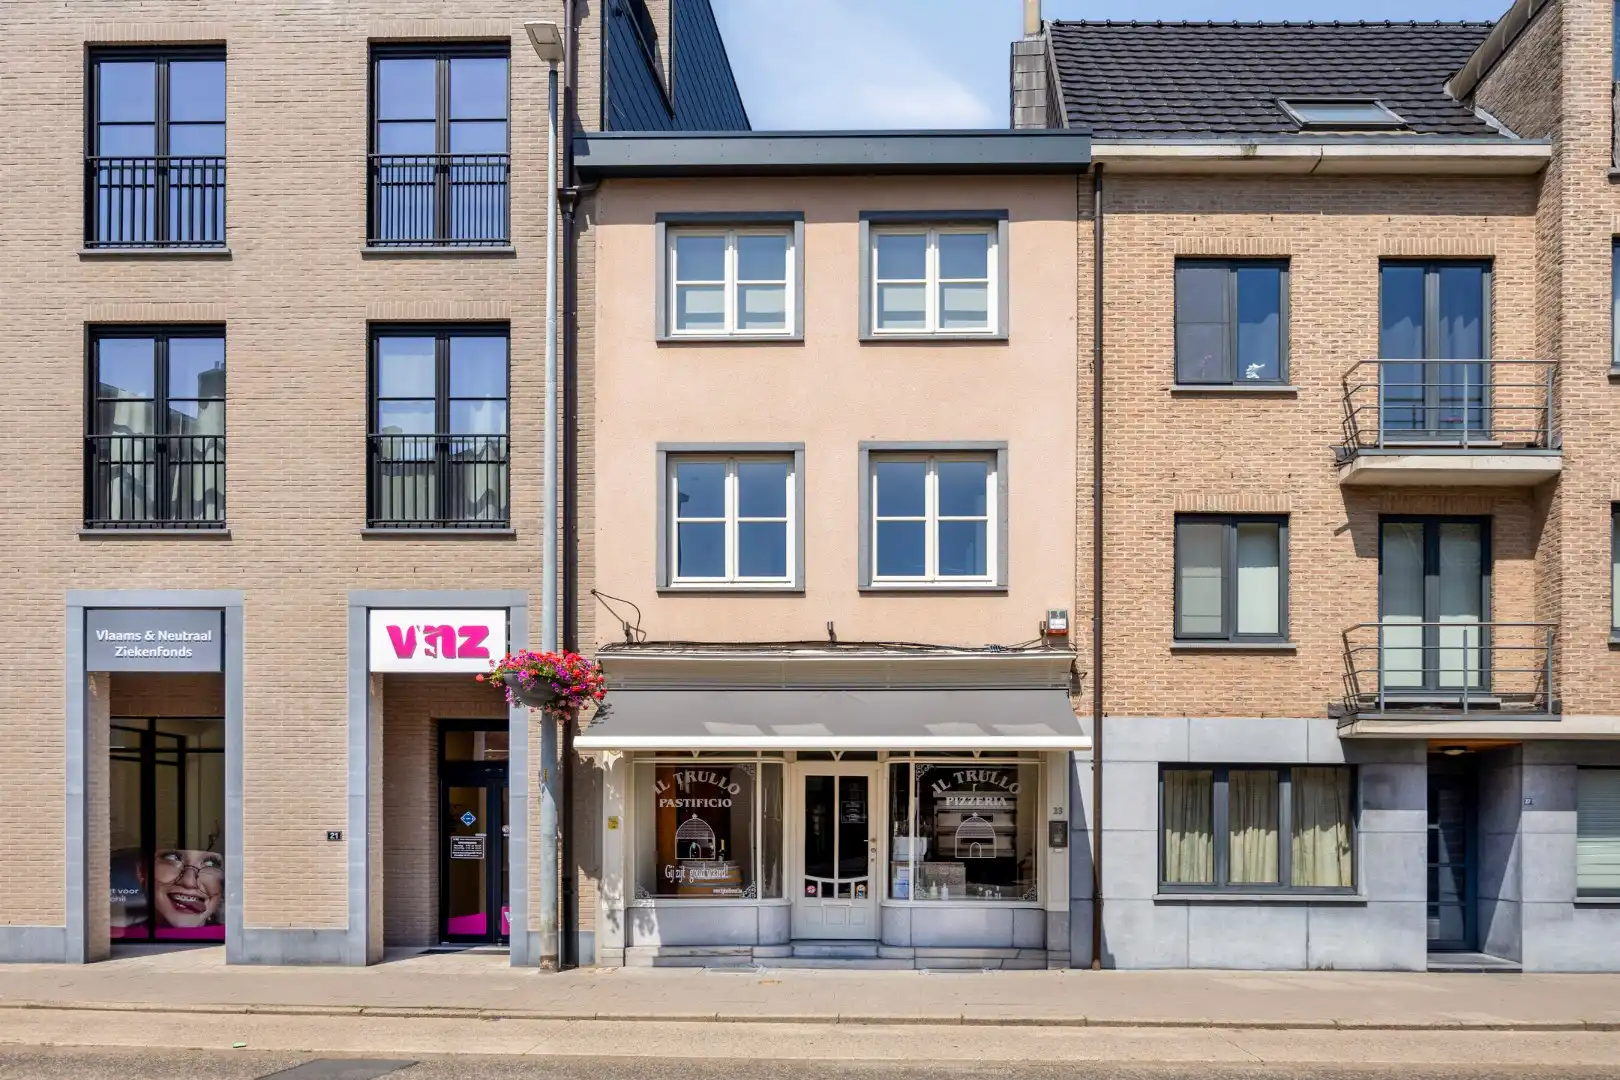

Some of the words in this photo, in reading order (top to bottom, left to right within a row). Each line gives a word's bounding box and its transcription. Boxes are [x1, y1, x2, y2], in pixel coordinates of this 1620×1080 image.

[95, 629, 142, 641] Vlaams
[144, 630, 156, 641] &
[158, 629, 213, 642] Neutraal
[114, 645, 194, 658] Ziekenfonds
[651, 779, 671, 796] IL
[673, 769, 741, 795] TRULLO
[931, 778, 952, 795] IL
[953, 769, 1021, 795] TRULLO
[659, 798, 733, 808] PASTIFICIO
[945, 796, 1008, 806] PIZZERIA
[330, 832, 339, 840] 21
[664, 864, 675, 883] Gij
